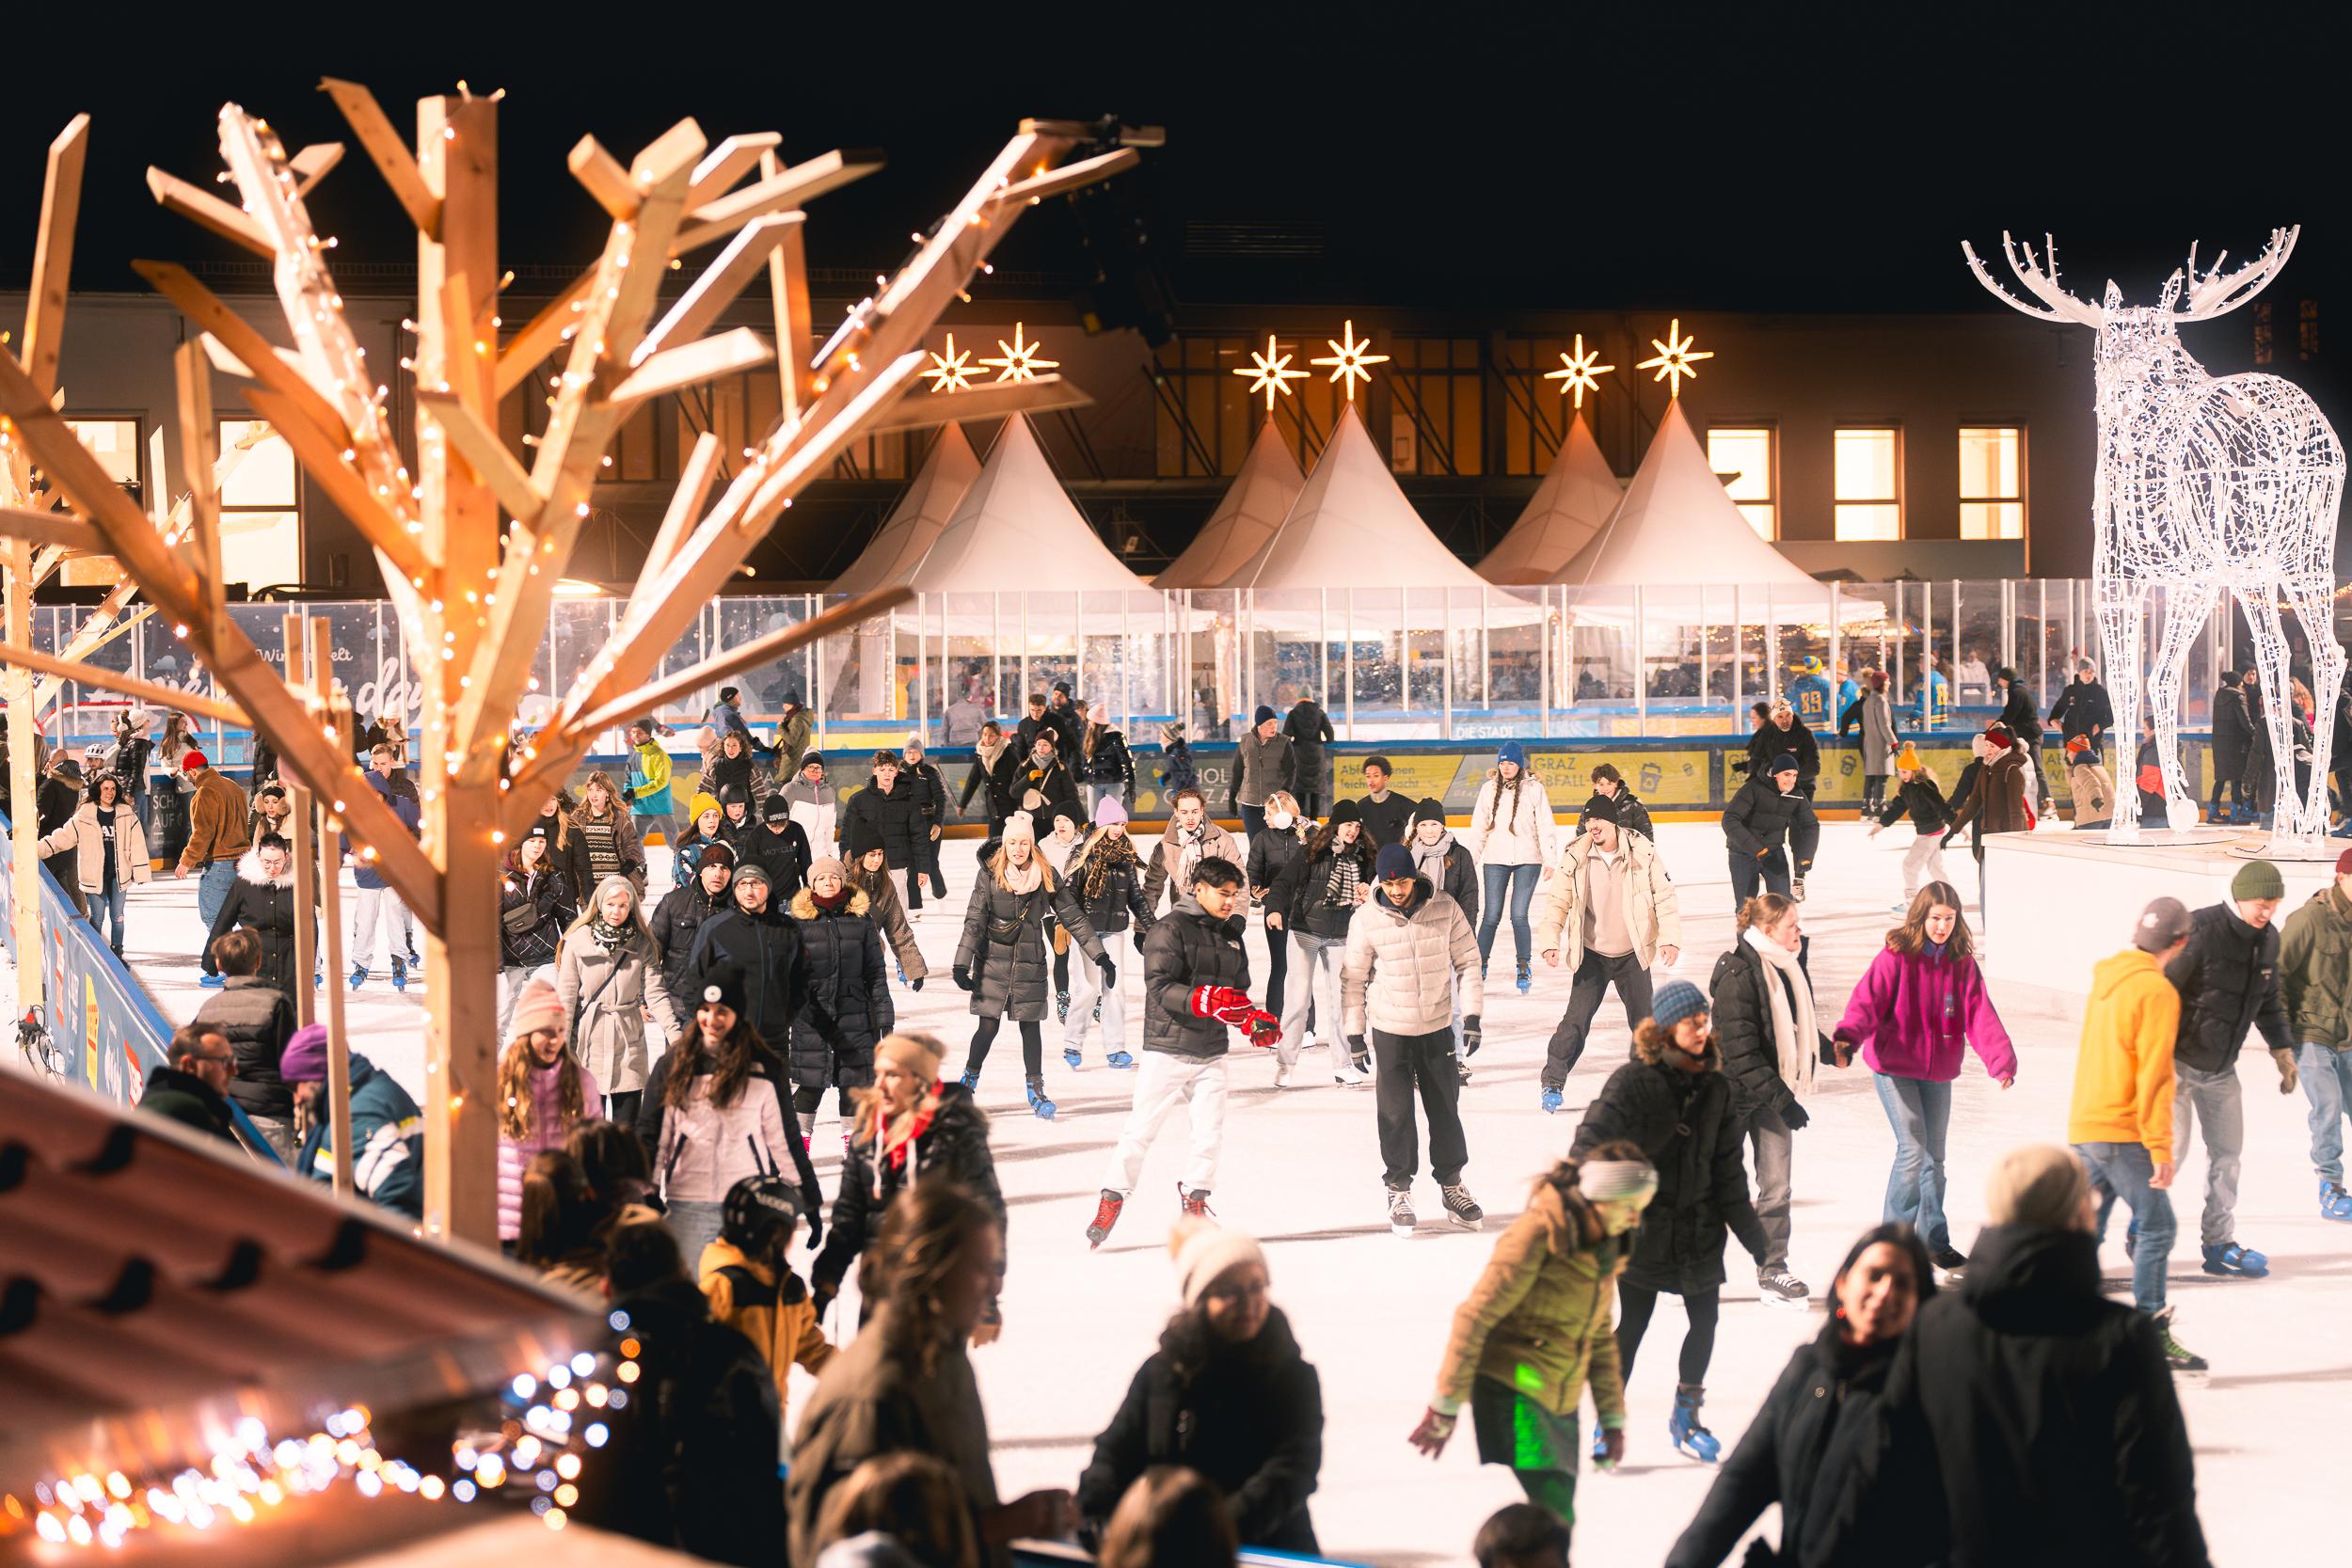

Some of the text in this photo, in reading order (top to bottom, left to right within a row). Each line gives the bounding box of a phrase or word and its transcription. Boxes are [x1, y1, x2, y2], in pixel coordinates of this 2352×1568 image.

[1456, 725, 1514, 738] DIE STADT
[1534, 756, 1577, 770] GRAZ
[152, 813, 175, 829] AUF
